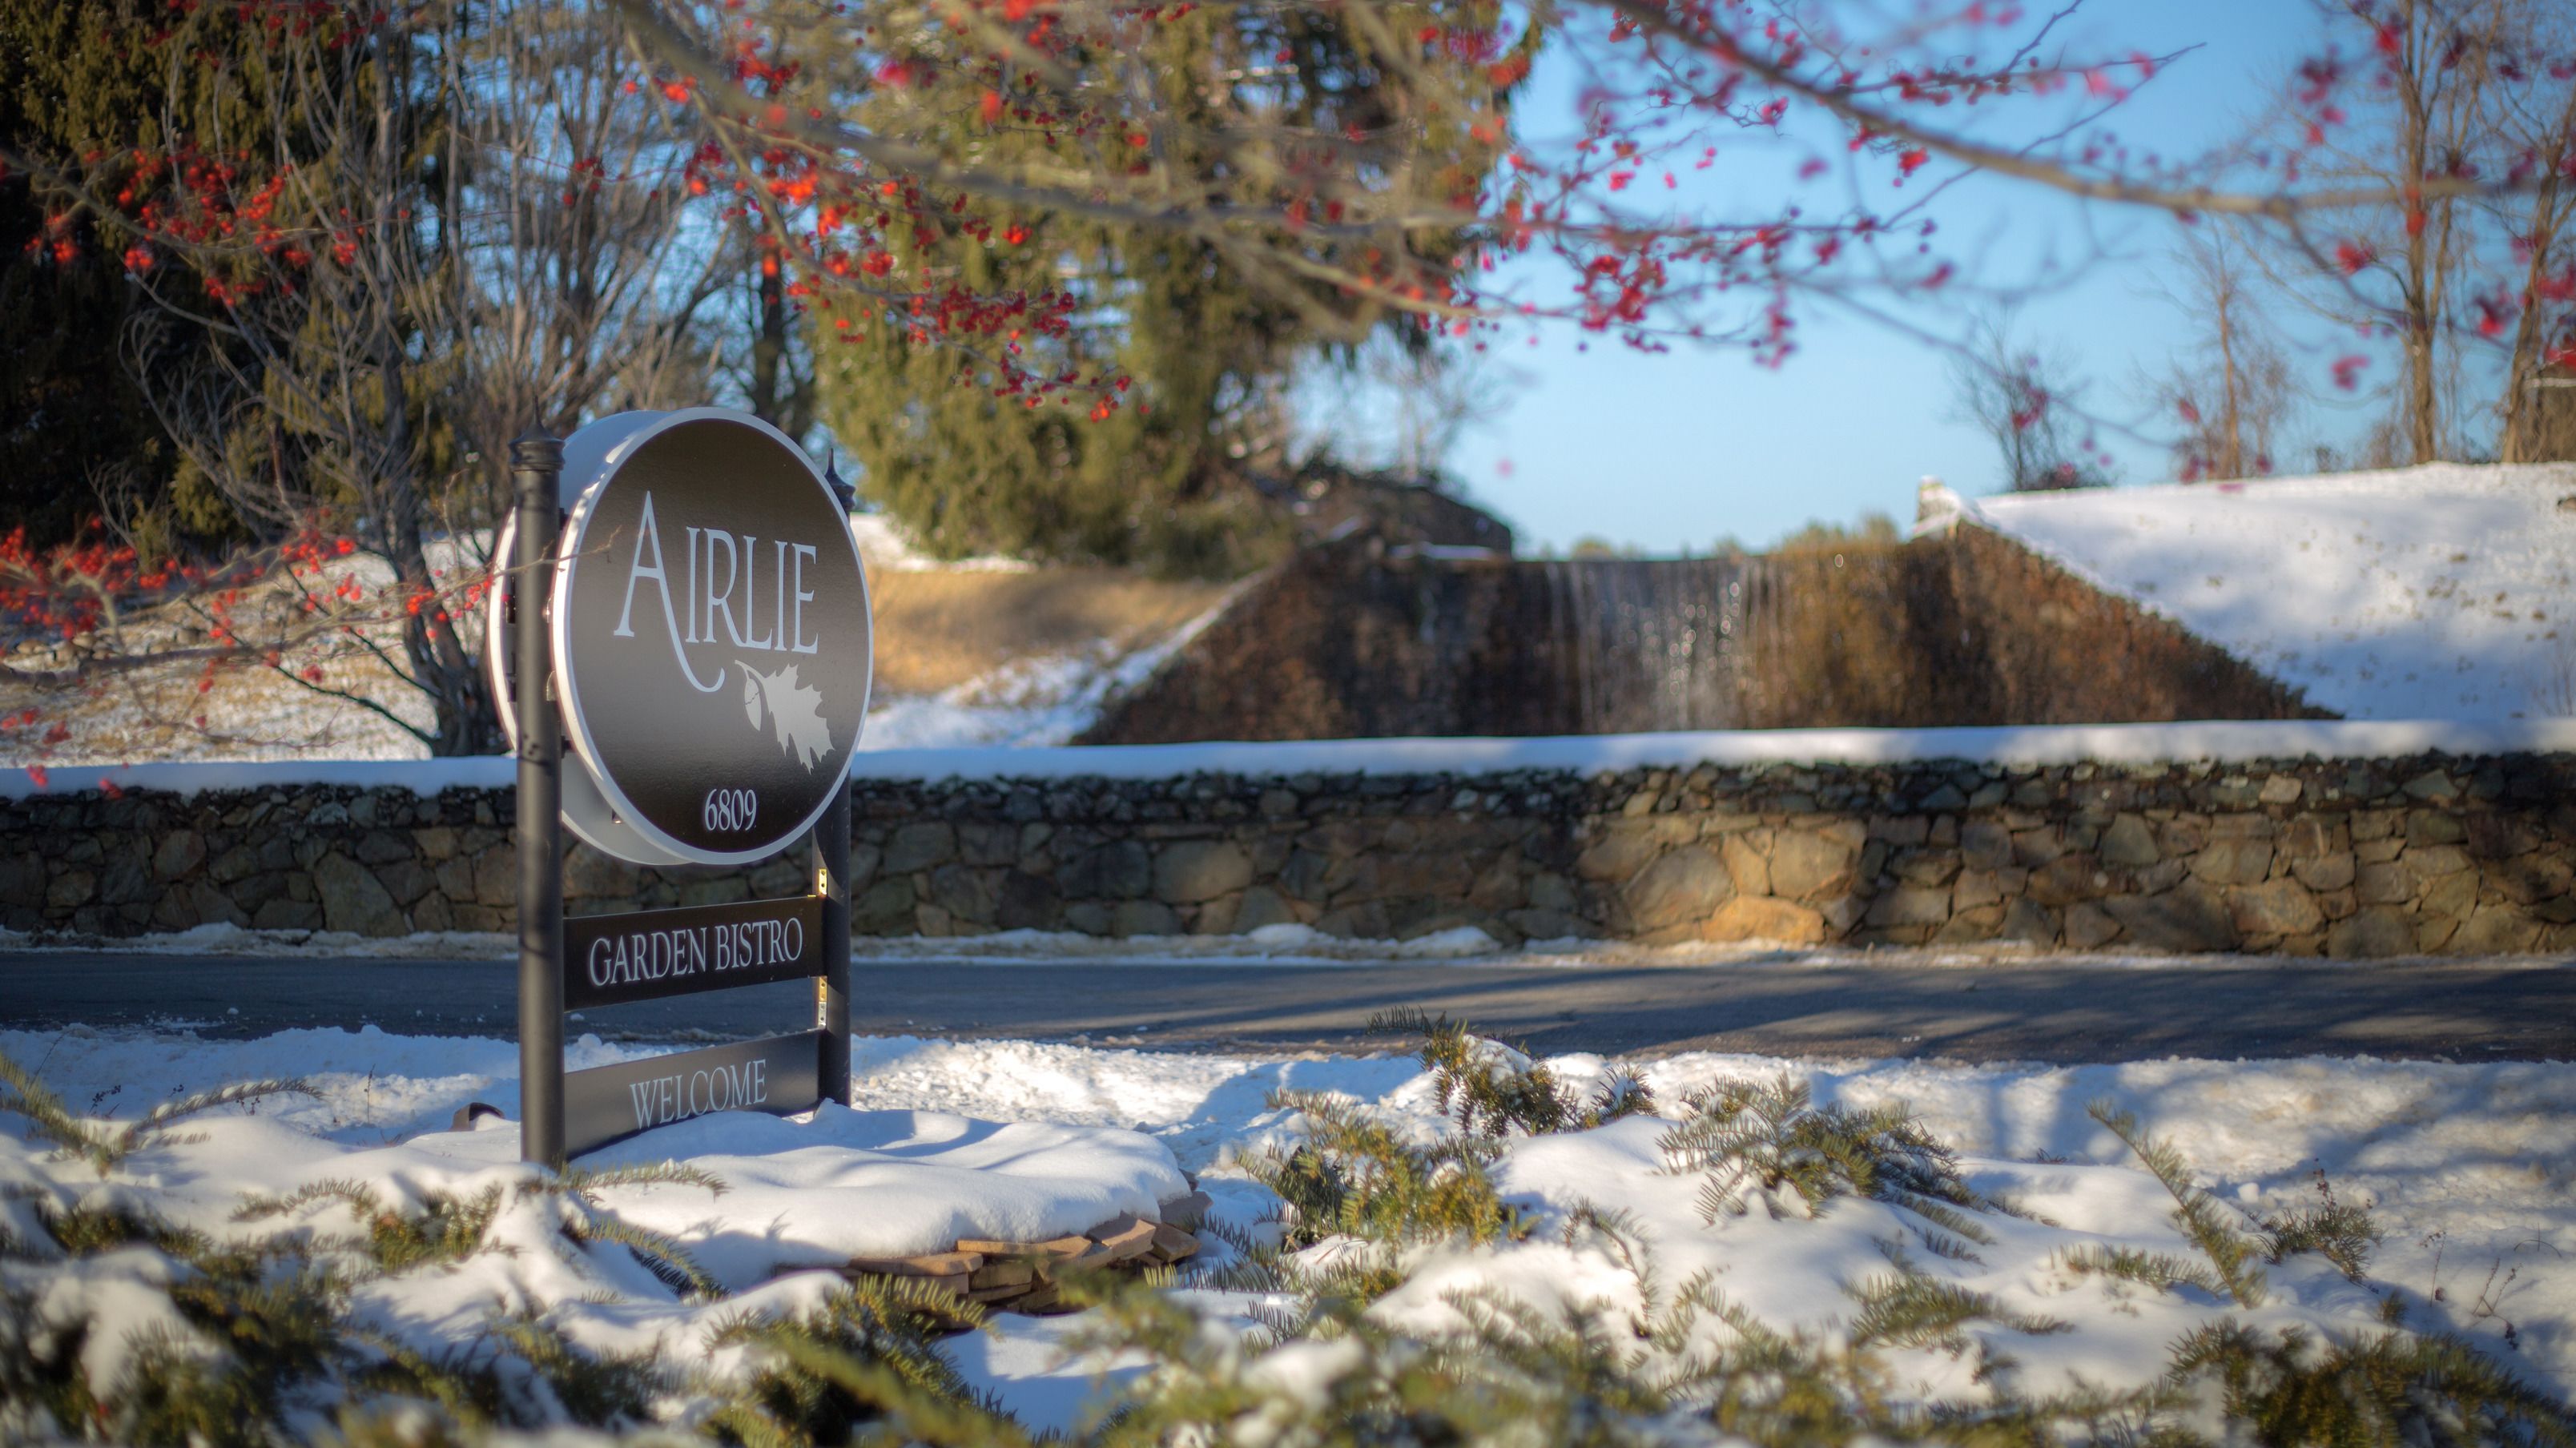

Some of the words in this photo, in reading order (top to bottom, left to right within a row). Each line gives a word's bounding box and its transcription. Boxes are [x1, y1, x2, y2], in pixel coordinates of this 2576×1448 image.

[704, 788, 757, 831] 6809
[589, 927, 706, 987] GARDEN
[714, 917, 803, 971] BISTRO
[629, 1058, 767, 1129] WELCOME
